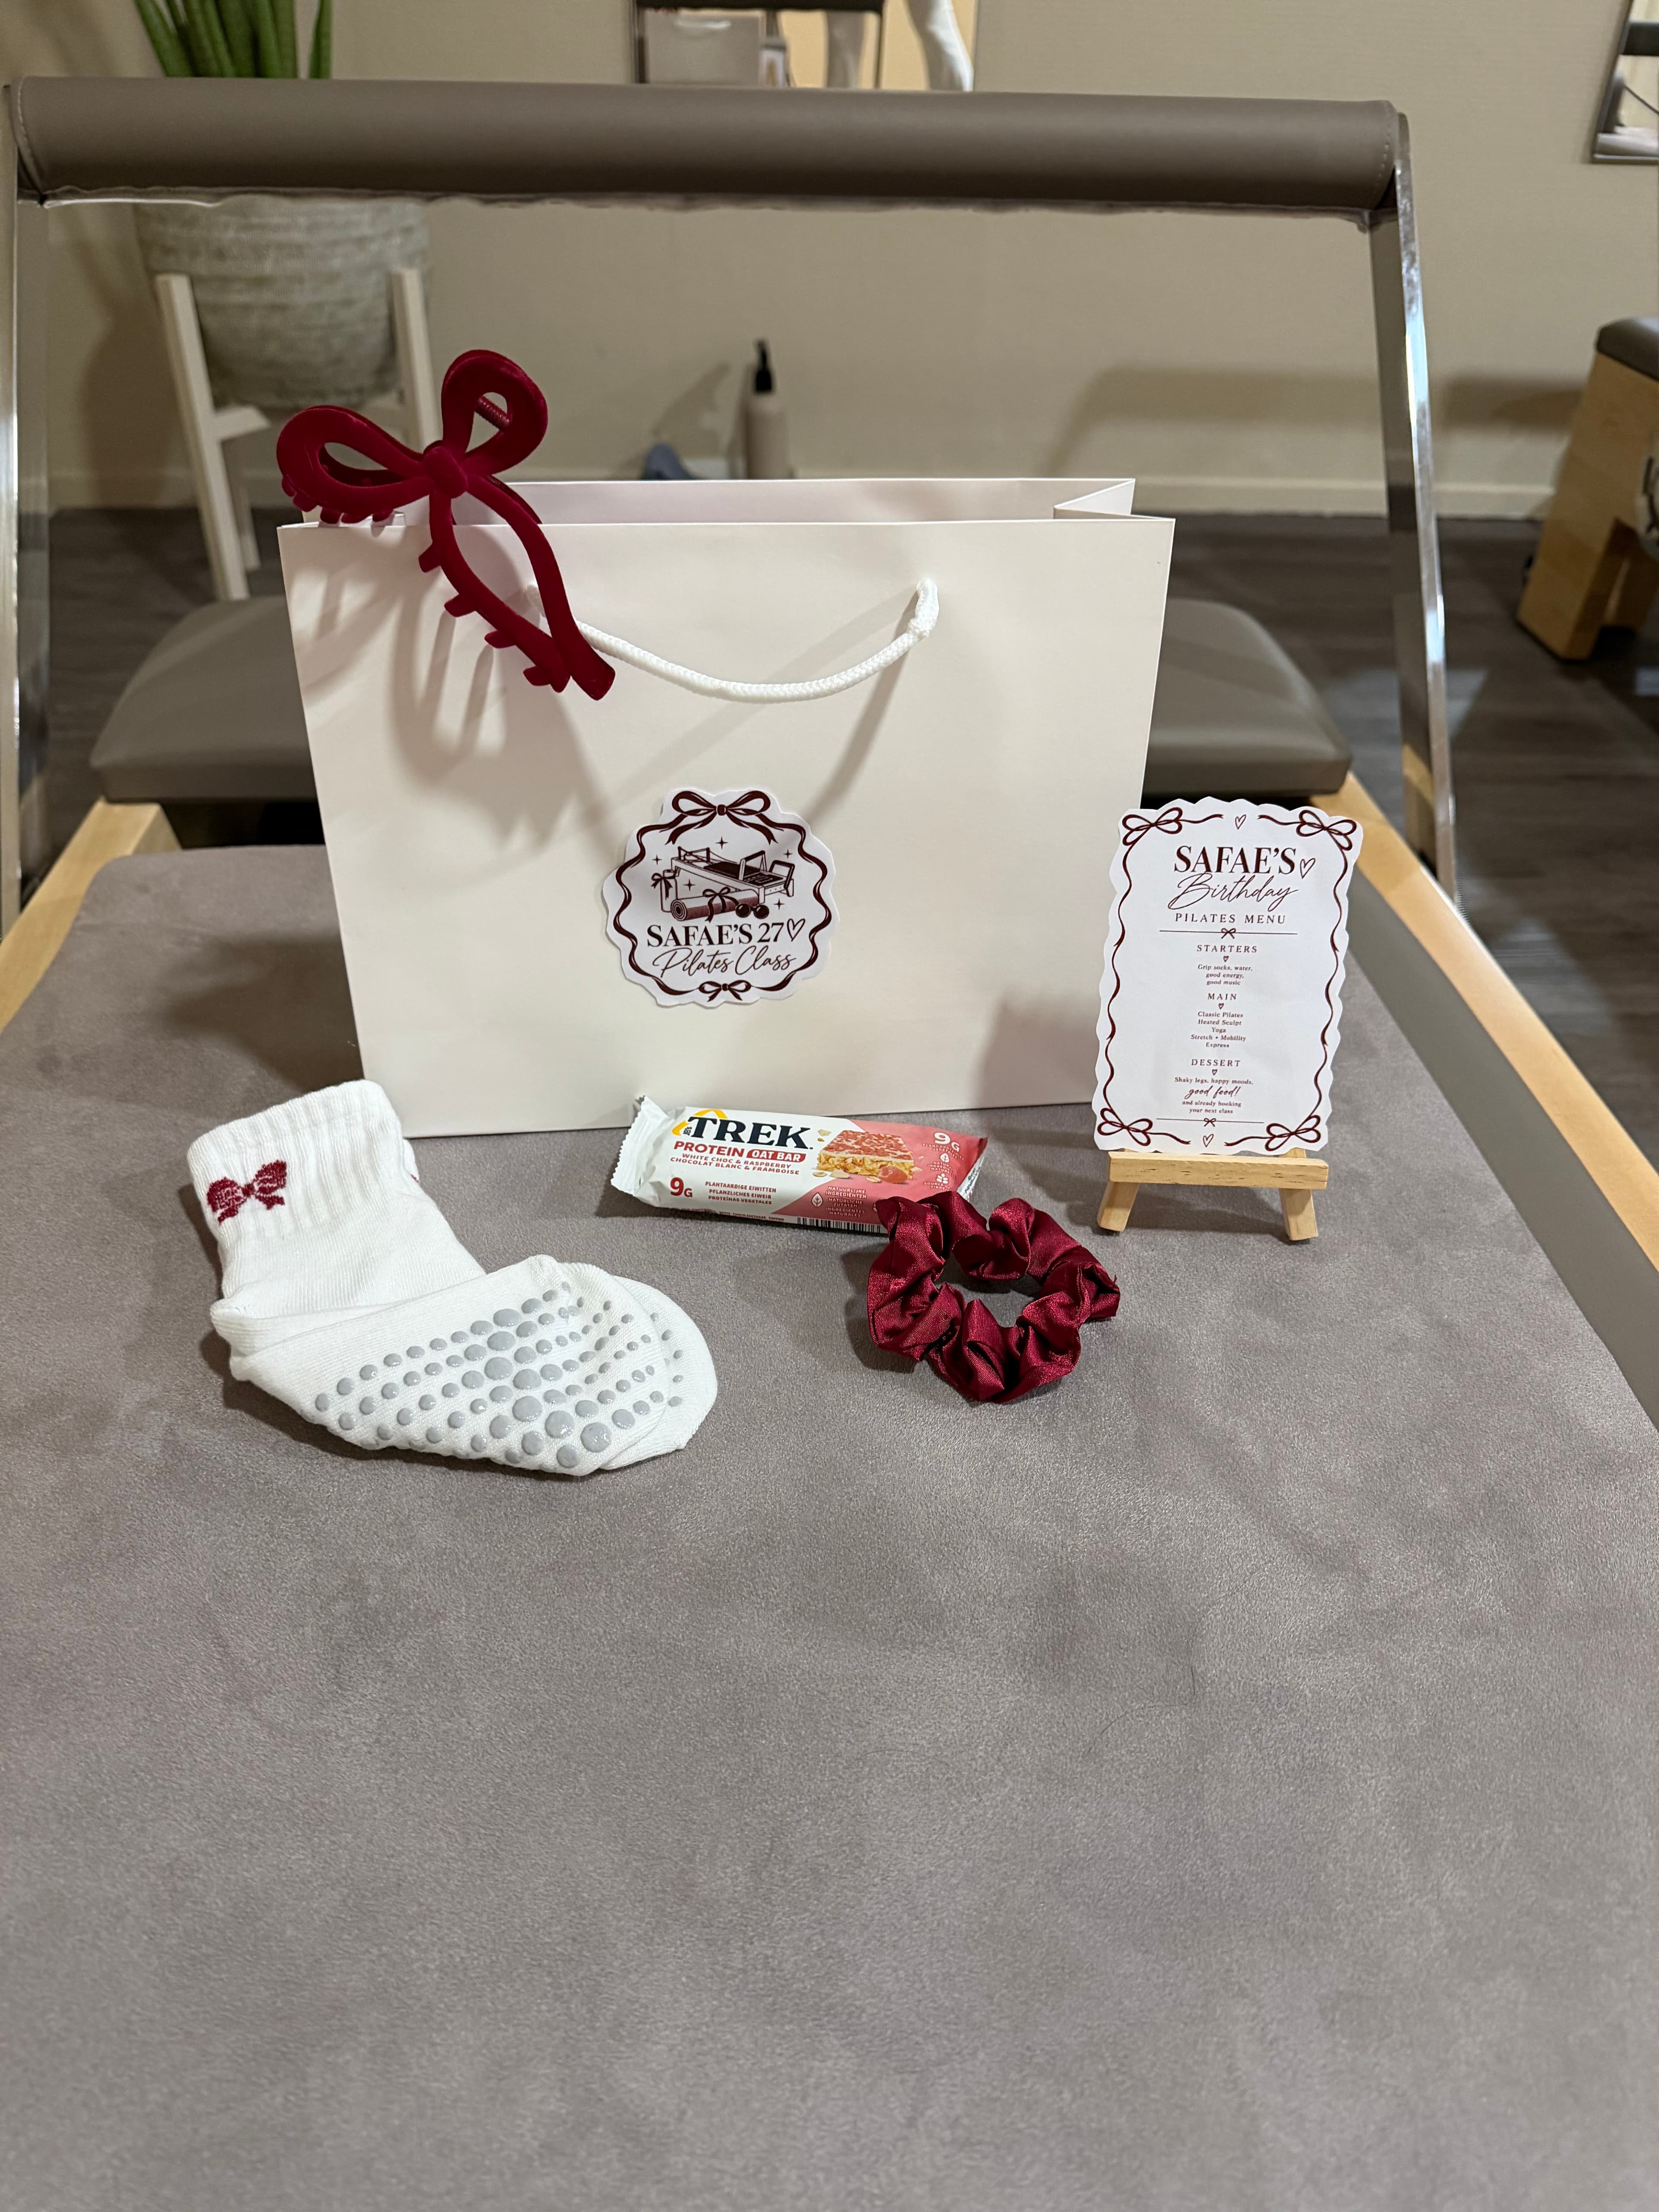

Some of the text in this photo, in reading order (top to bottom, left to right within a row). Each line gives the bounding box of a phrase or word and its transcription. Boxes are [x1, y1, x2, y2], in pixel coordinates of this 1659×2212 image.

[1174, 845, 1297, 875] SAFAE'S
[1168, 873, 1298, 912] Birthday
[1175, 913, 1287, 925] PILATES MENU
[647, 922, 784, 947] SAFAE'S 27
[1197, 944, 1257, 953] STARTERS
[652, 946, 797, 978] Pilates Class
[1184, 1085, 1241, 1100] good food!
[674, 1141, 801, 1161] PROTEIN OAT BAR
[671, 1157, 712, 1166] CHOCOLAT
[753, 1166, 800, 1175] FRAMBOISE
[744, 1160, 791, 1169] RASPBERRY
[705, 1181, 748, 1190] PLANTAARDIGE
[709, 1189, 750, 1197] PFLANZLICHES
